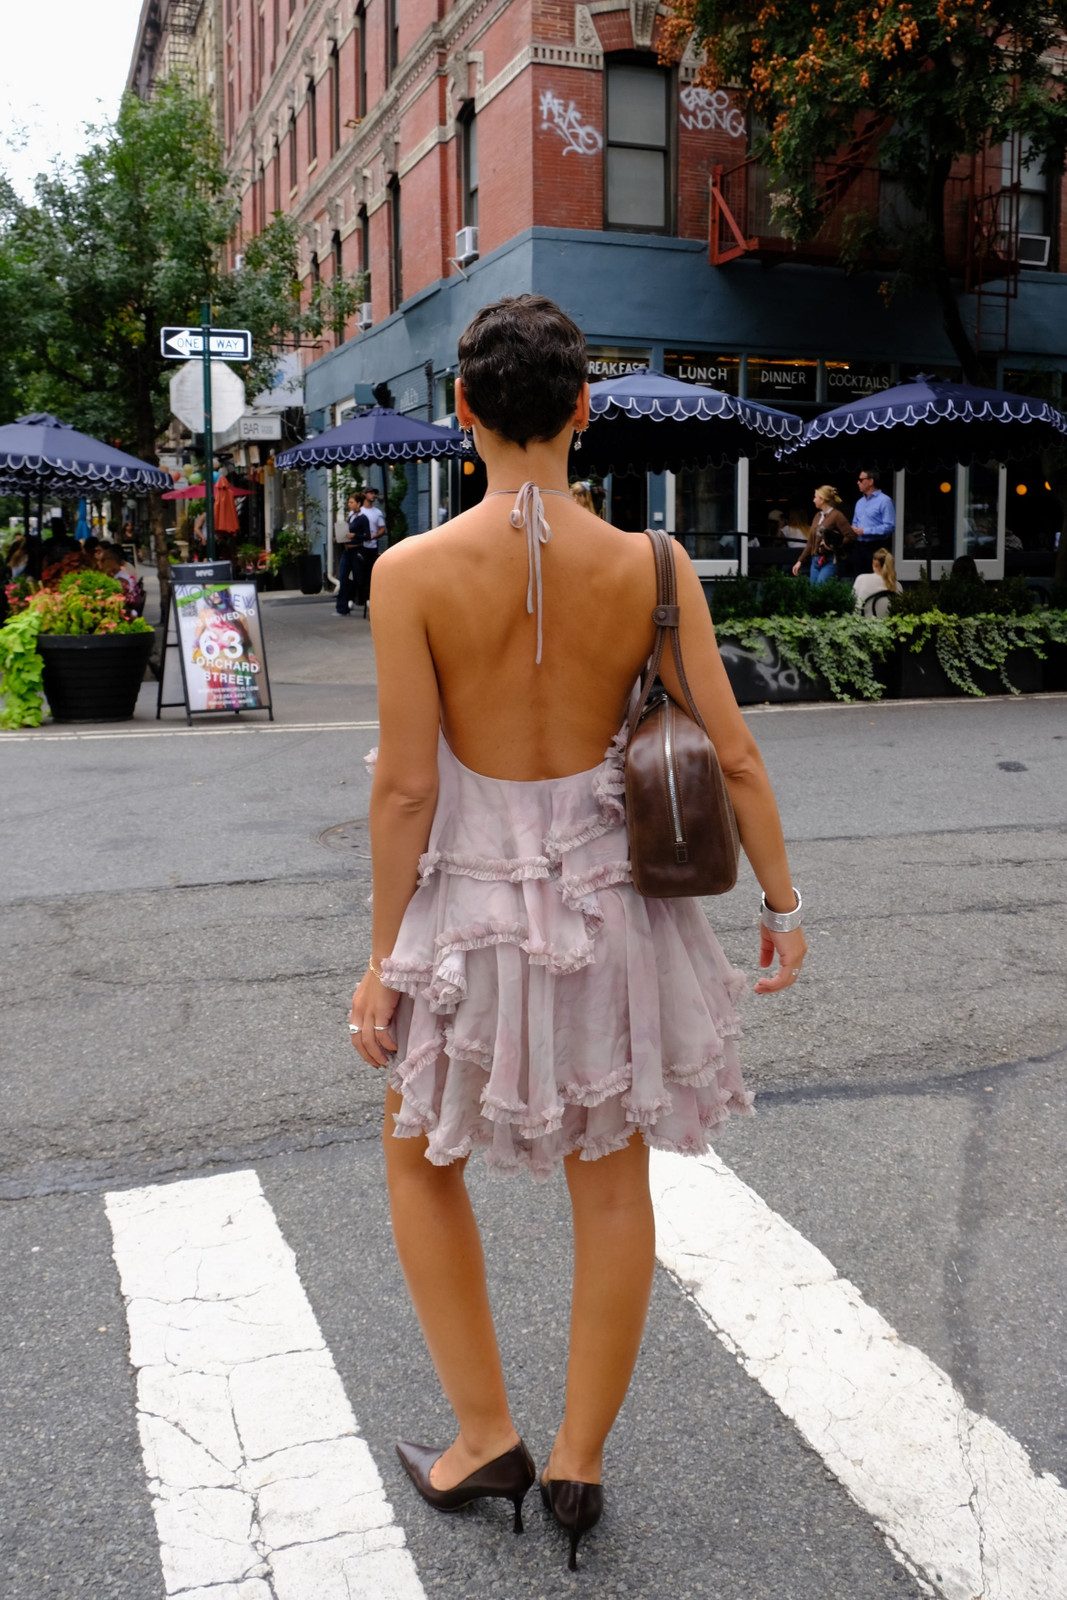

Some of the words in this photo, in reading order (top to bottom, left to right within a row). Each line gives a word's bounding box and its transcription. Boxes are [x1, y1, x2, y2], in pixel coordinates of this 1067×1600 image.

[177, 338, 200, 349] ONE
[216, 340, 239, 349] WAY
[678, 365, 728, 380] LUNCH
[761, 370, 806, 384] DINNER
[828, 373, 889, 388] COCKTAILS
[243, 423, 259, 434] BAR
[195, 569, 213, 577] NYC
[199, 630, 244, 660] 63
[196, 656, 260, 673] ORCHARD
[204, 672, 252, 686] STREET
